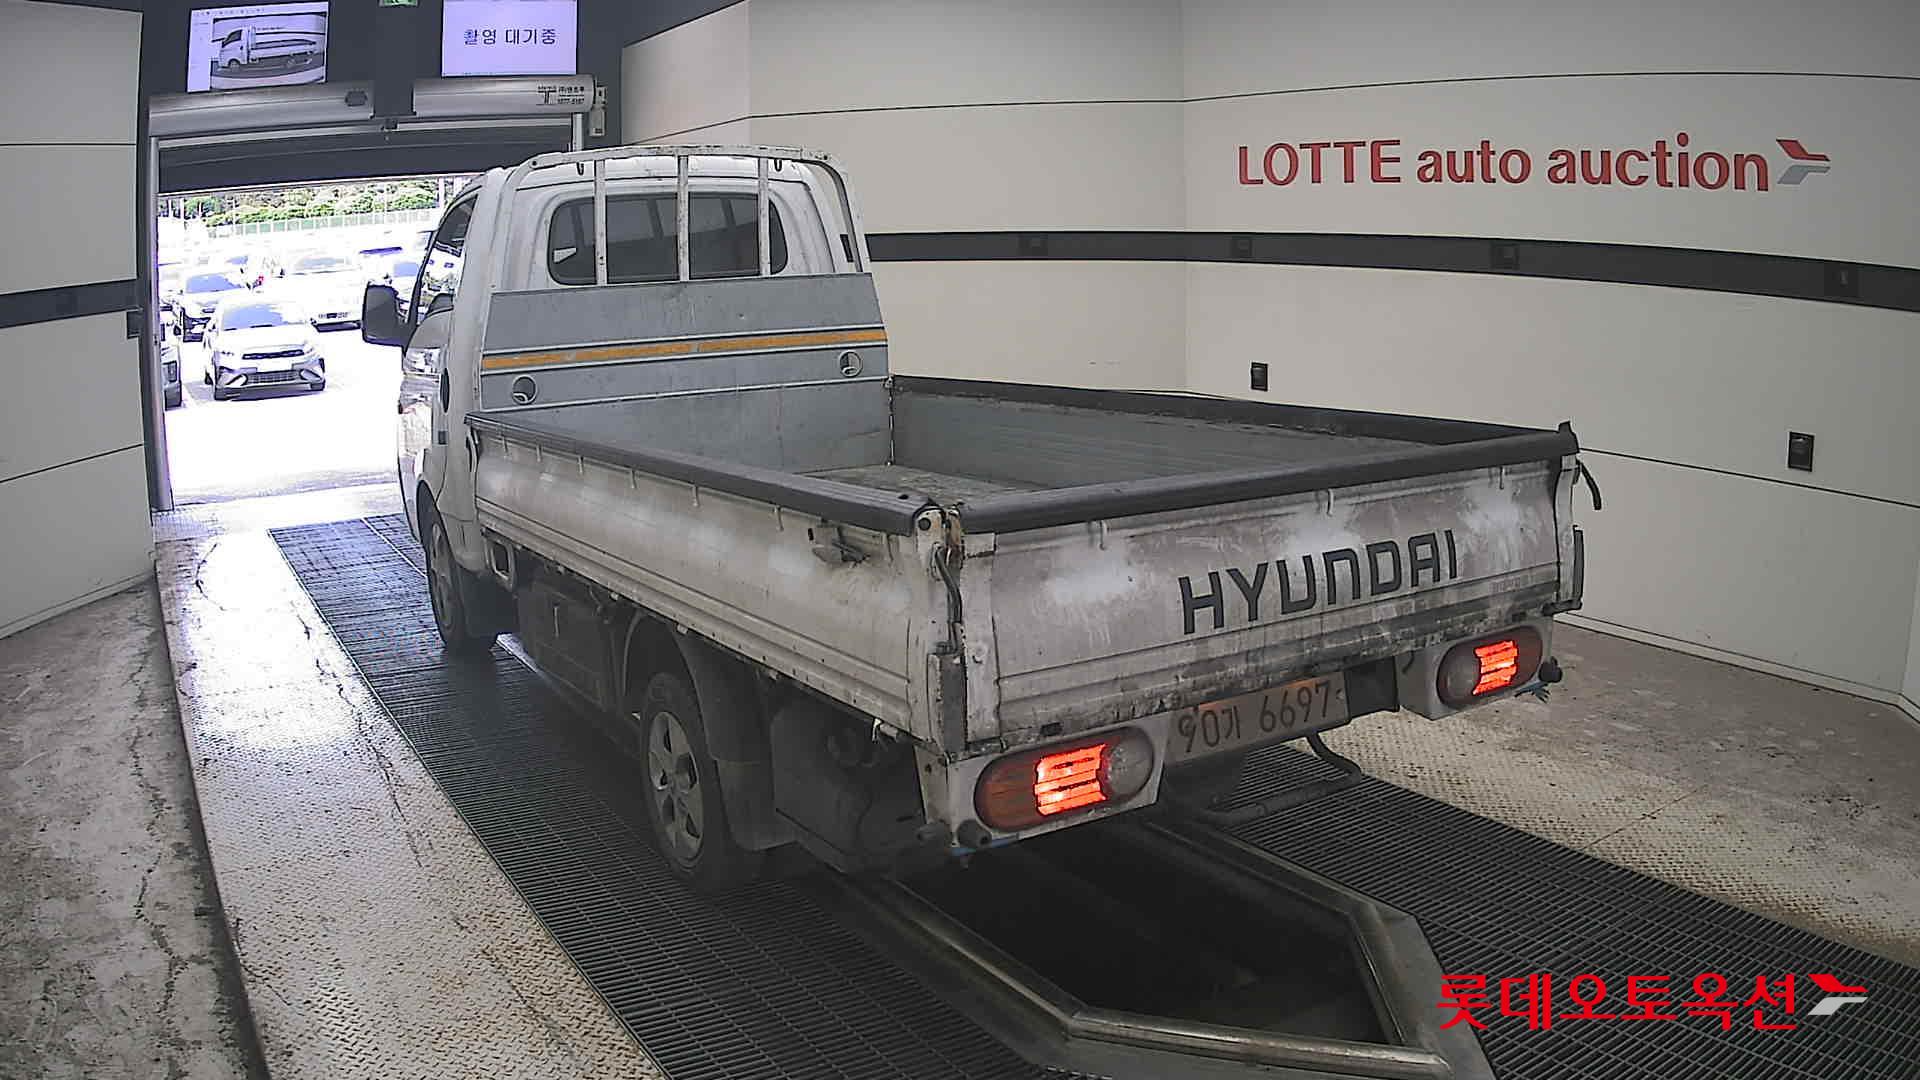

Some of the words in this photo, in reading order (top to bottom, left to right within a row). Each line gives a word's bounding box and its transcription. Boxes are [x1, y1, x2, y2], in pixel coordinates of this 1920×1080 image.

[463, 28, 497, 45] 촬영
[505, 28, 557, 45] 대기중
[1238, 140, 1401, 186] LOTTE
[1417, 140, 1531, 185] auto
[1547, 132, 1769, 191] auction
[1178, 529, 1459, 635] HYUNDAI
[1259, 680, 1330, 733] 6697
